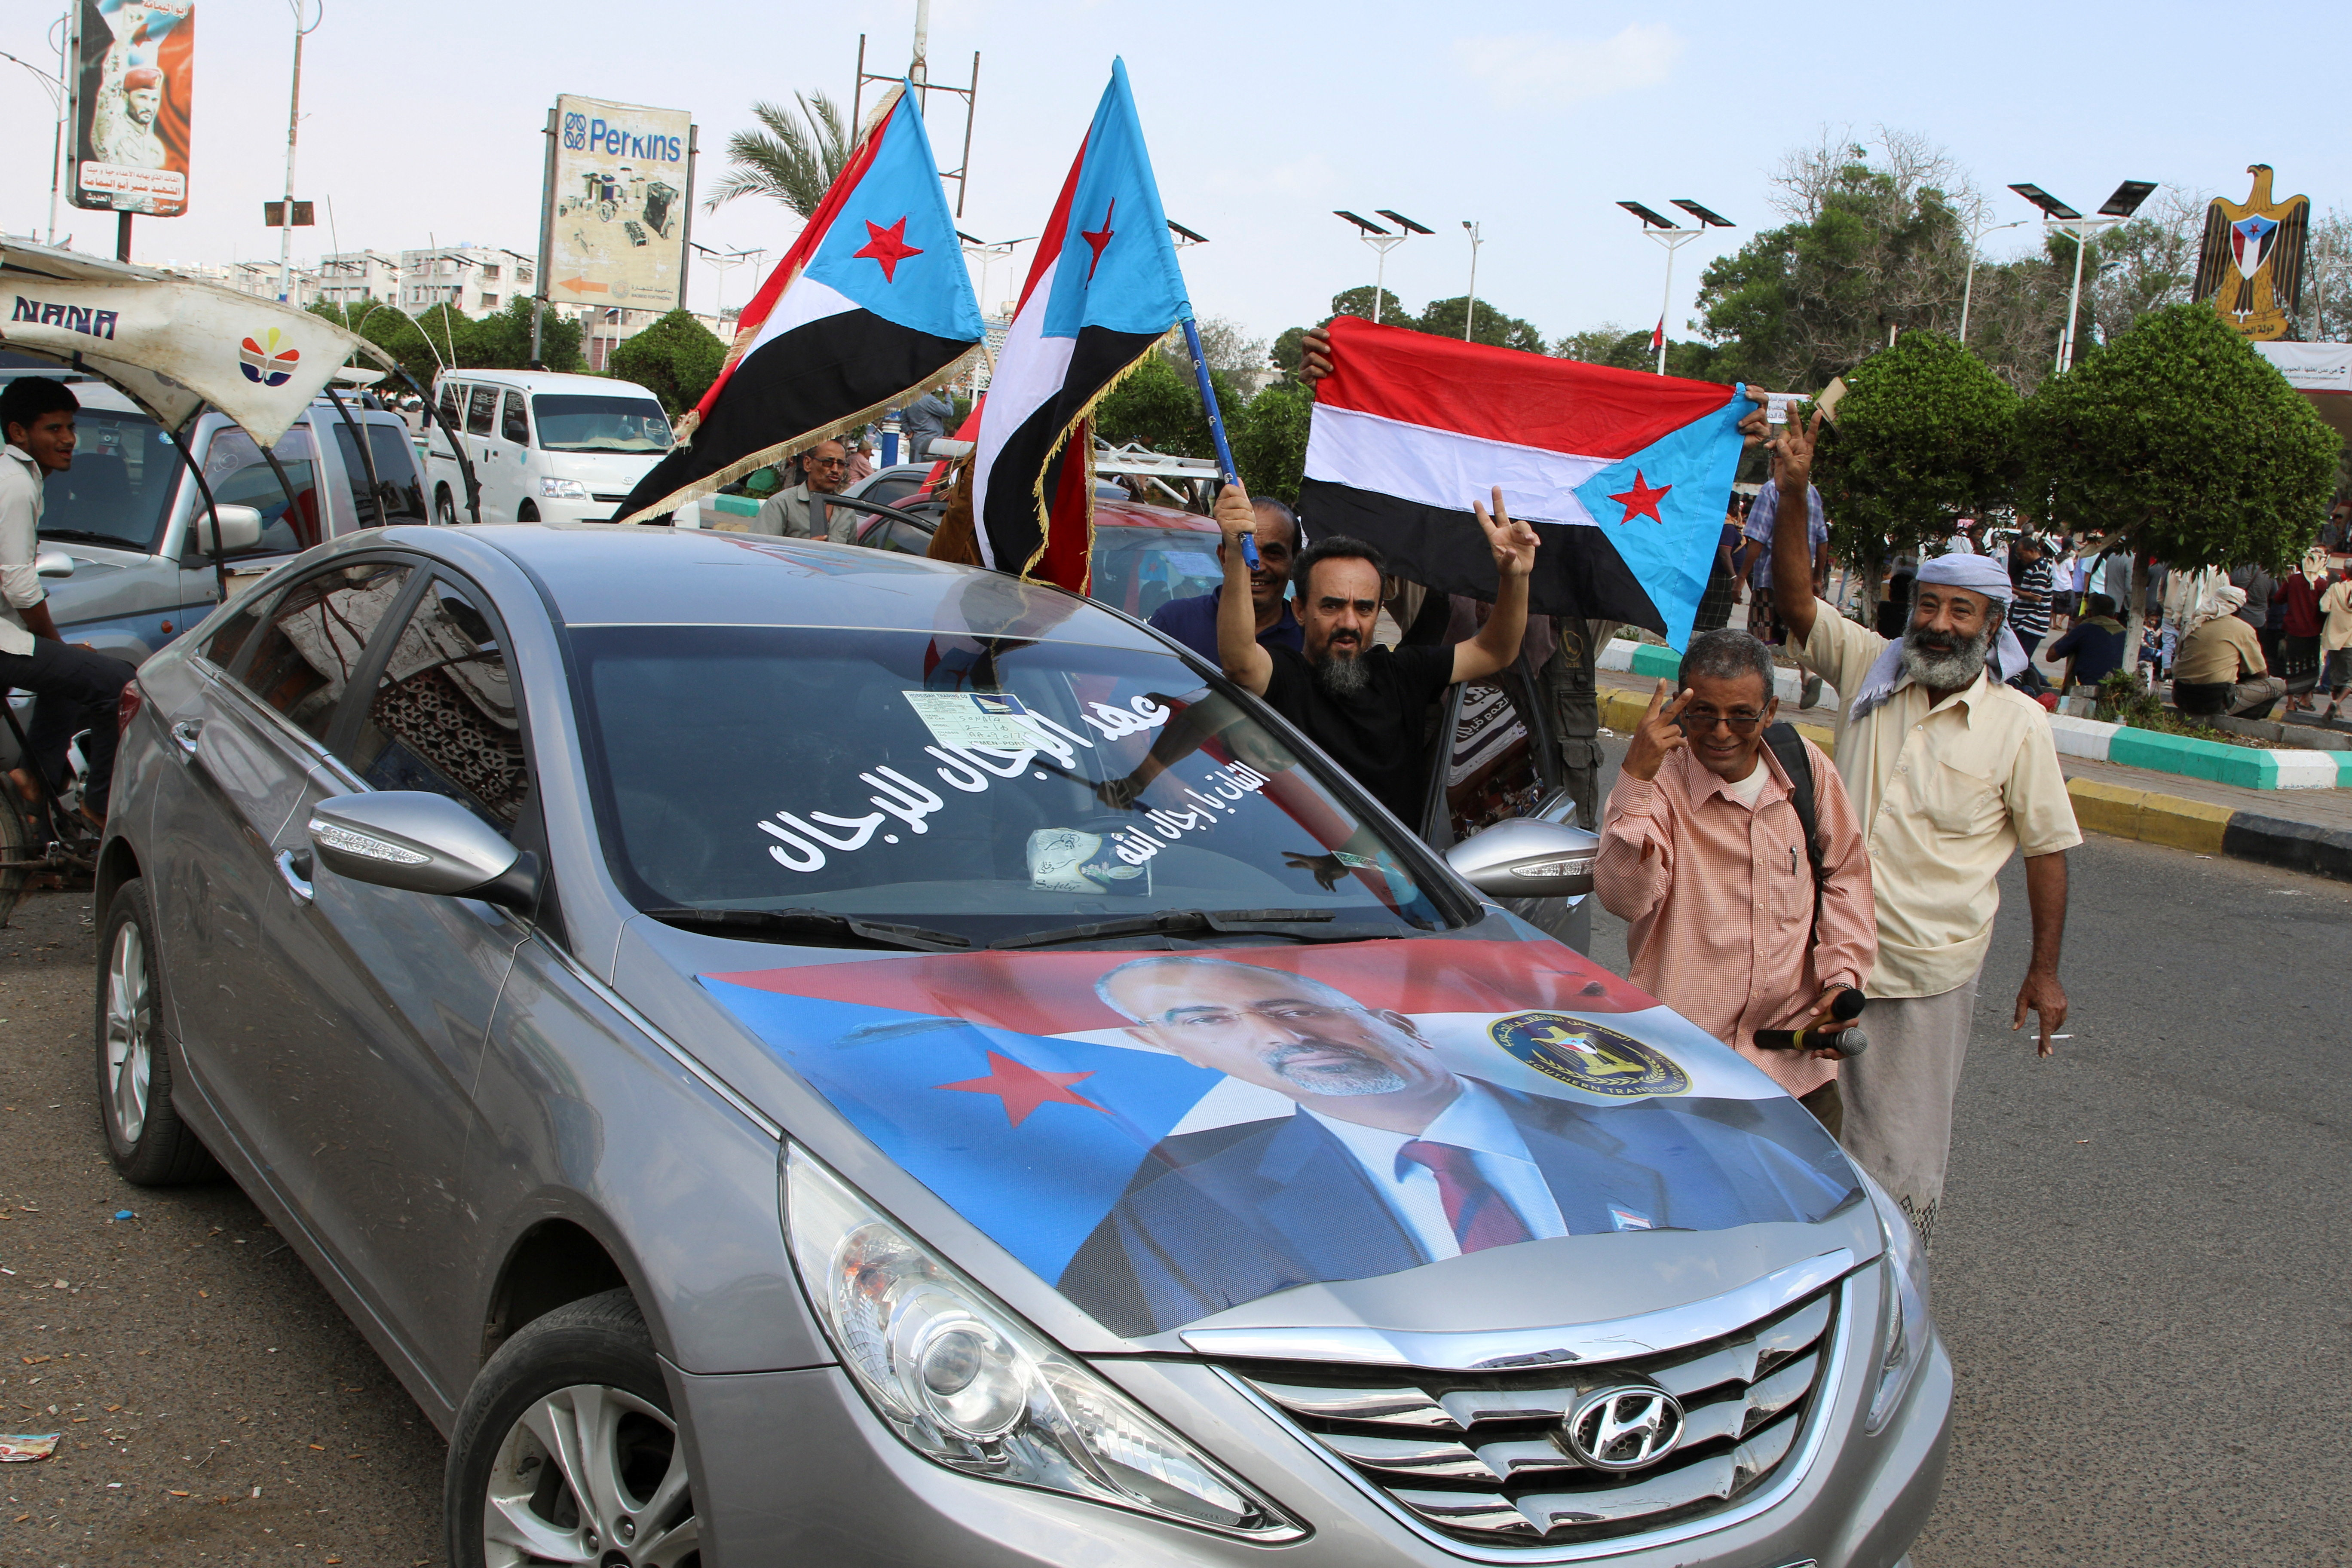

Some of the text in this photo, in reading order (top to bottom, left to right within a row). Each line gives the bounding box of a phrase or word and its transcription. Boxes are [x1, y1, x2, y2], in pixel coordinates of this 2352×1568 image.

[144, 0, 173, 15] اليمامة
[590, 118, 681, 162] Perkins
[84, 176, 180, 195] الشهيد منير أبو اليمامة
[151, 174, 163, 182] الذي
[86, 192, 110, 203] الحديث
[11, 295, 119, 340] NANA
[2257, 324, 2275, 335] دولة
[757, 695, 1171, 872] عهد الرجال للرجال
[1183, 787, 1236, 815] يا
[1145, 803, 1217, 839] رجال
[1111, 825, 1167, 865] الله
[1033, 879, 1076, 891] Softly
[1496, 1014, 1632, 1047] المجلس الانتقالي الجنوبي
[1526, 1055, 1684, 1095] SOUTHERN TRANSITIONAL COUNCIL
